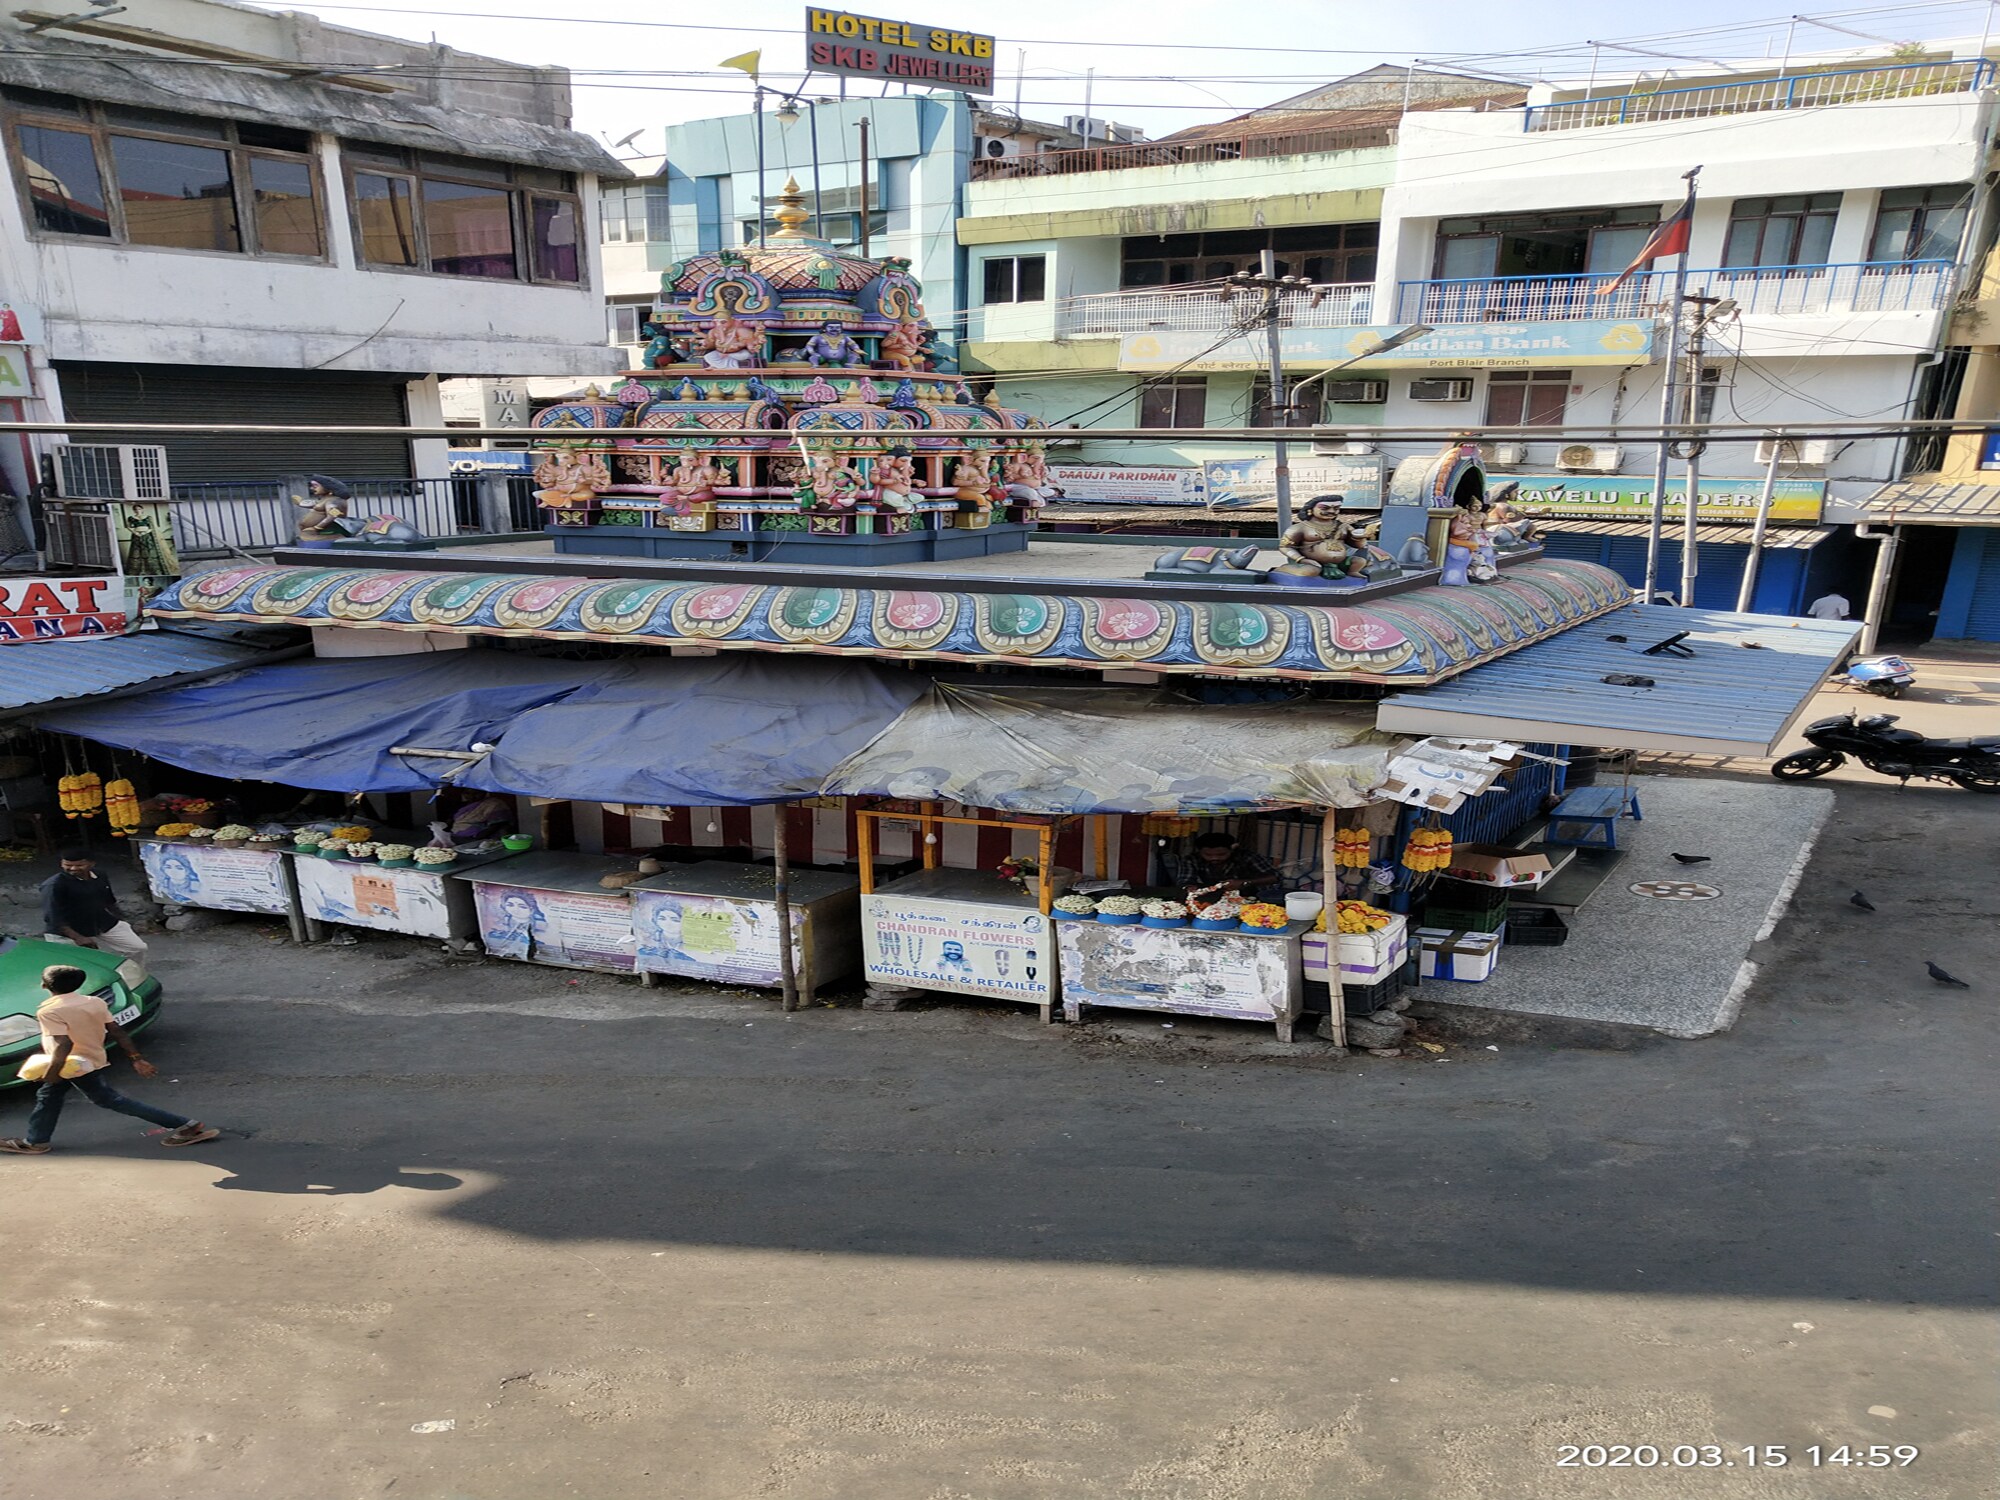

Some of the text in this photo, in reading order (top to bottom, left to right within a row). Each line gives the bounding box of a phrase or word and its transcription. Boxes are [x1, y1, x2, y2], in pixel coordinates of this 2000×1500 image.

[811, 10, 993, 58] HOTEL SKB
[811, 42, 993, 88] SKB JEWELLERY
[1491, 336, 1571, 350] Bank
[1429, 358, 1530, 368] Port Blair Branch
[1058, 470, 1177, 481] DAAUJI PARIDHAN
[1630, 491, 1775, 508] TRADERS
[876, 921, 1035, 946] CHANDRAN FLOWERS
[868, 964, 1047, 993] WHOLESALE & RETAILER
